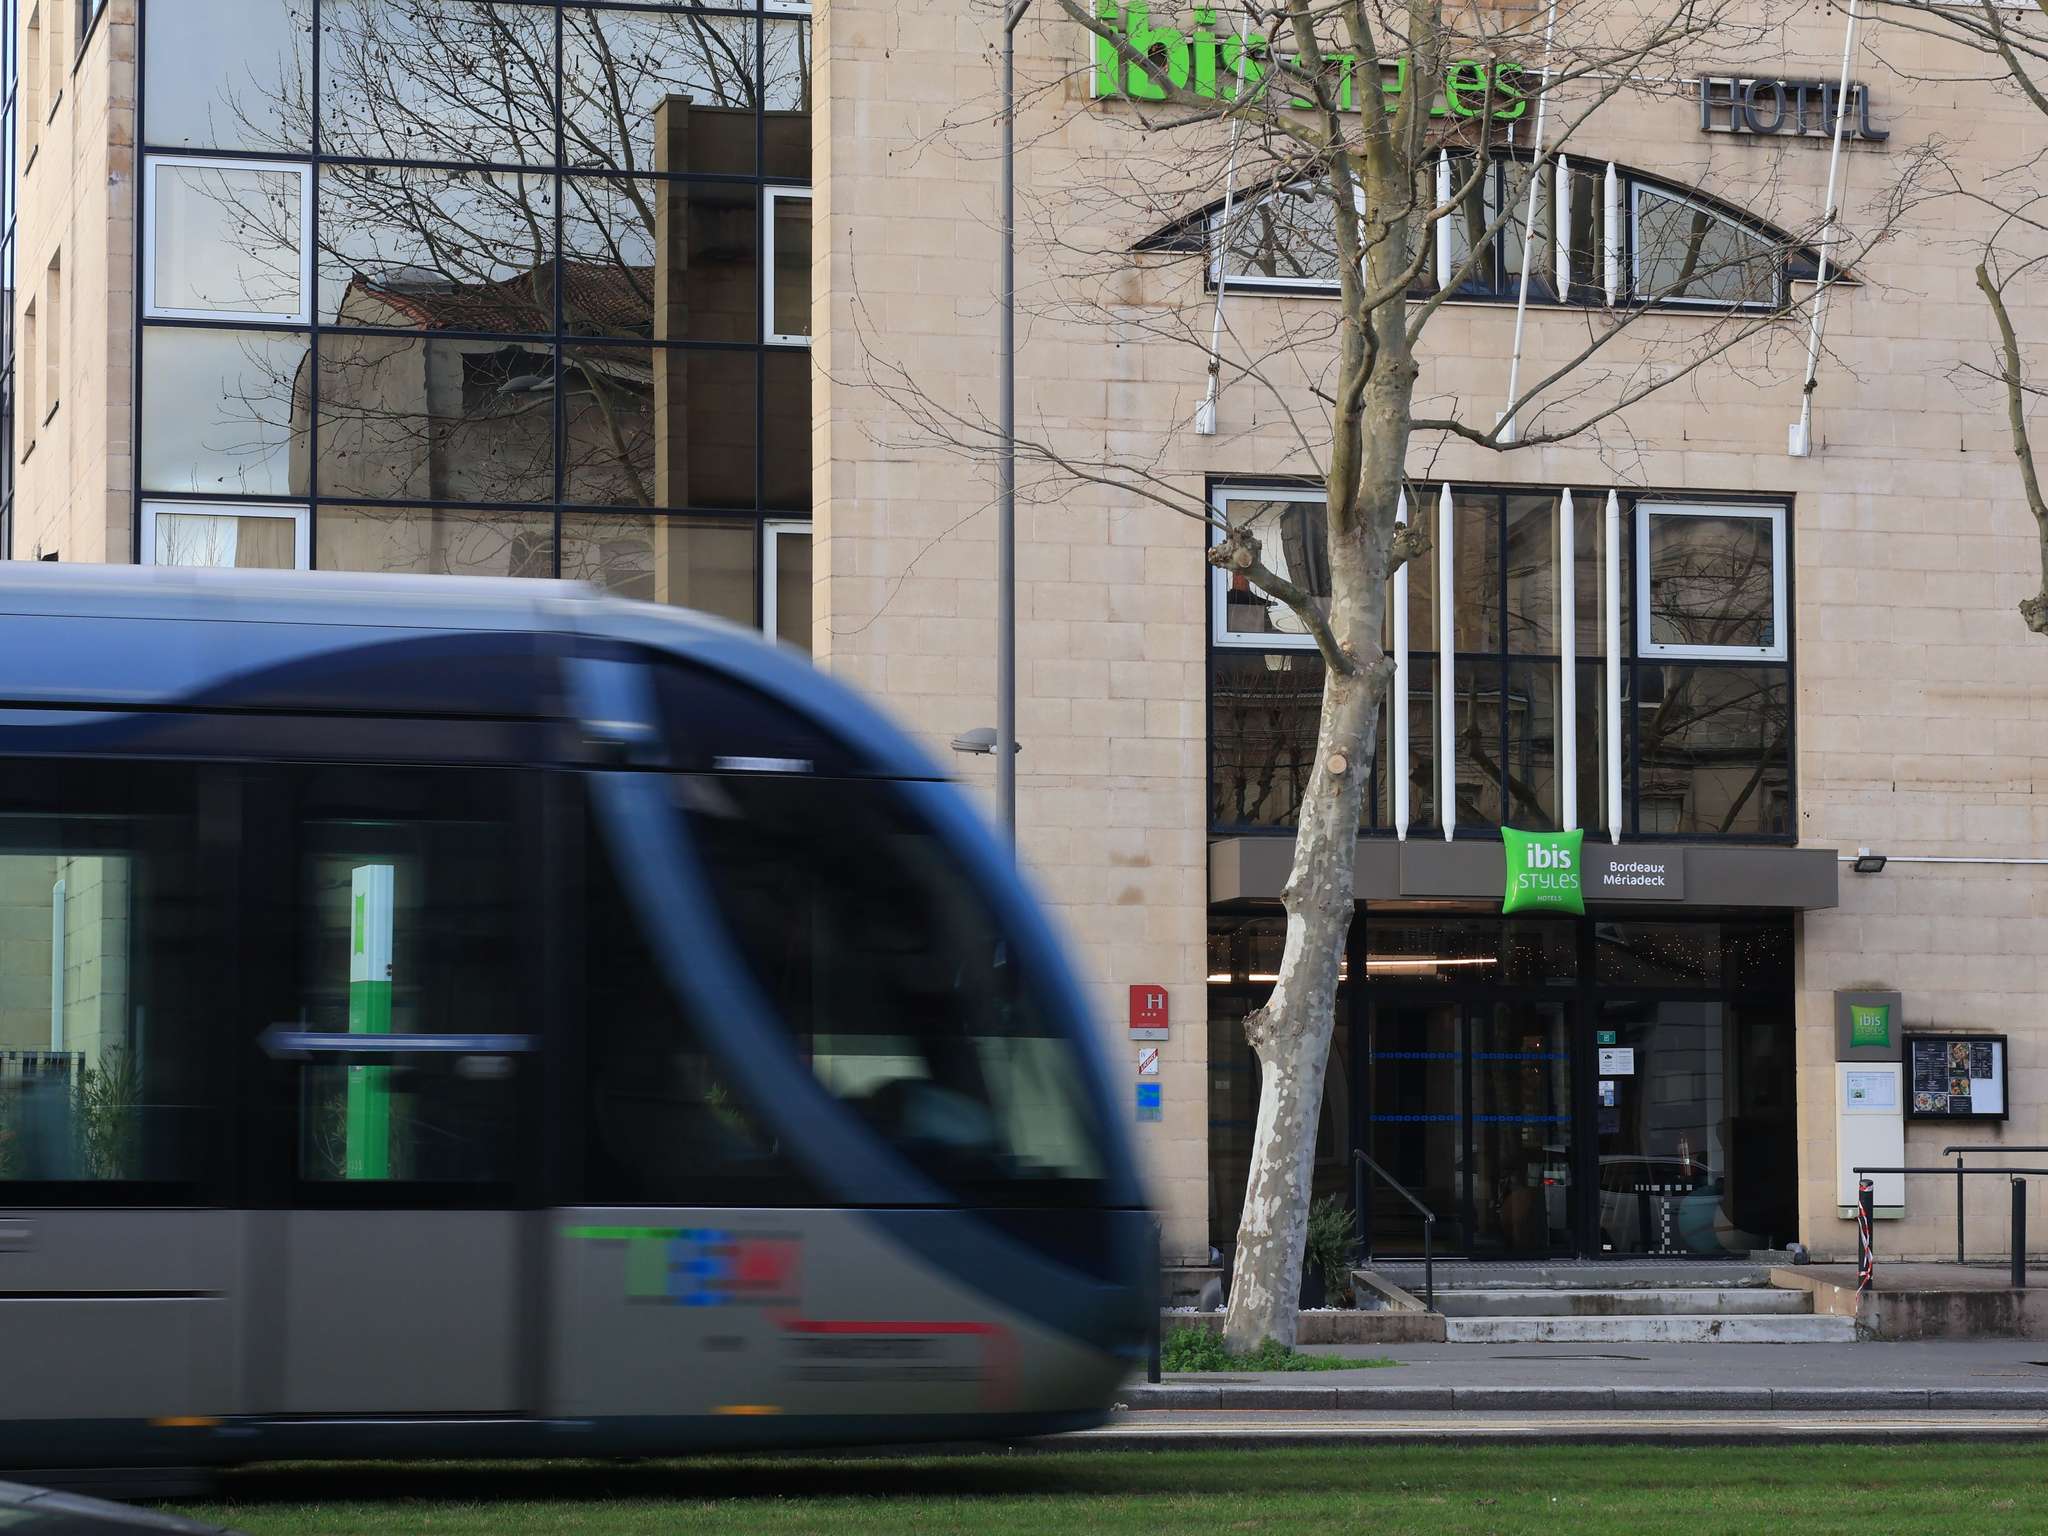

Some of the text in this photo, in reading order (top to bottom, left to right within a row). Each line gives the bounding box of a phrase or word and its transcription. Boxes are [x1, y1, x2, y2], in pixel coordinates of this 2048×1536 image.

[1096, 0, 1267, 102] ibis
[1701, 77, 1890, 140] HOTEL
[1527, 842, 1571, 869] ibis
[1609, 861, 1665, 873] Bordeaux
[1603, 873, 1665, 886] Mériadeck
[1147, 993, 1163, 1009] H
[1859, 1012, 1881, 1026] ibis
